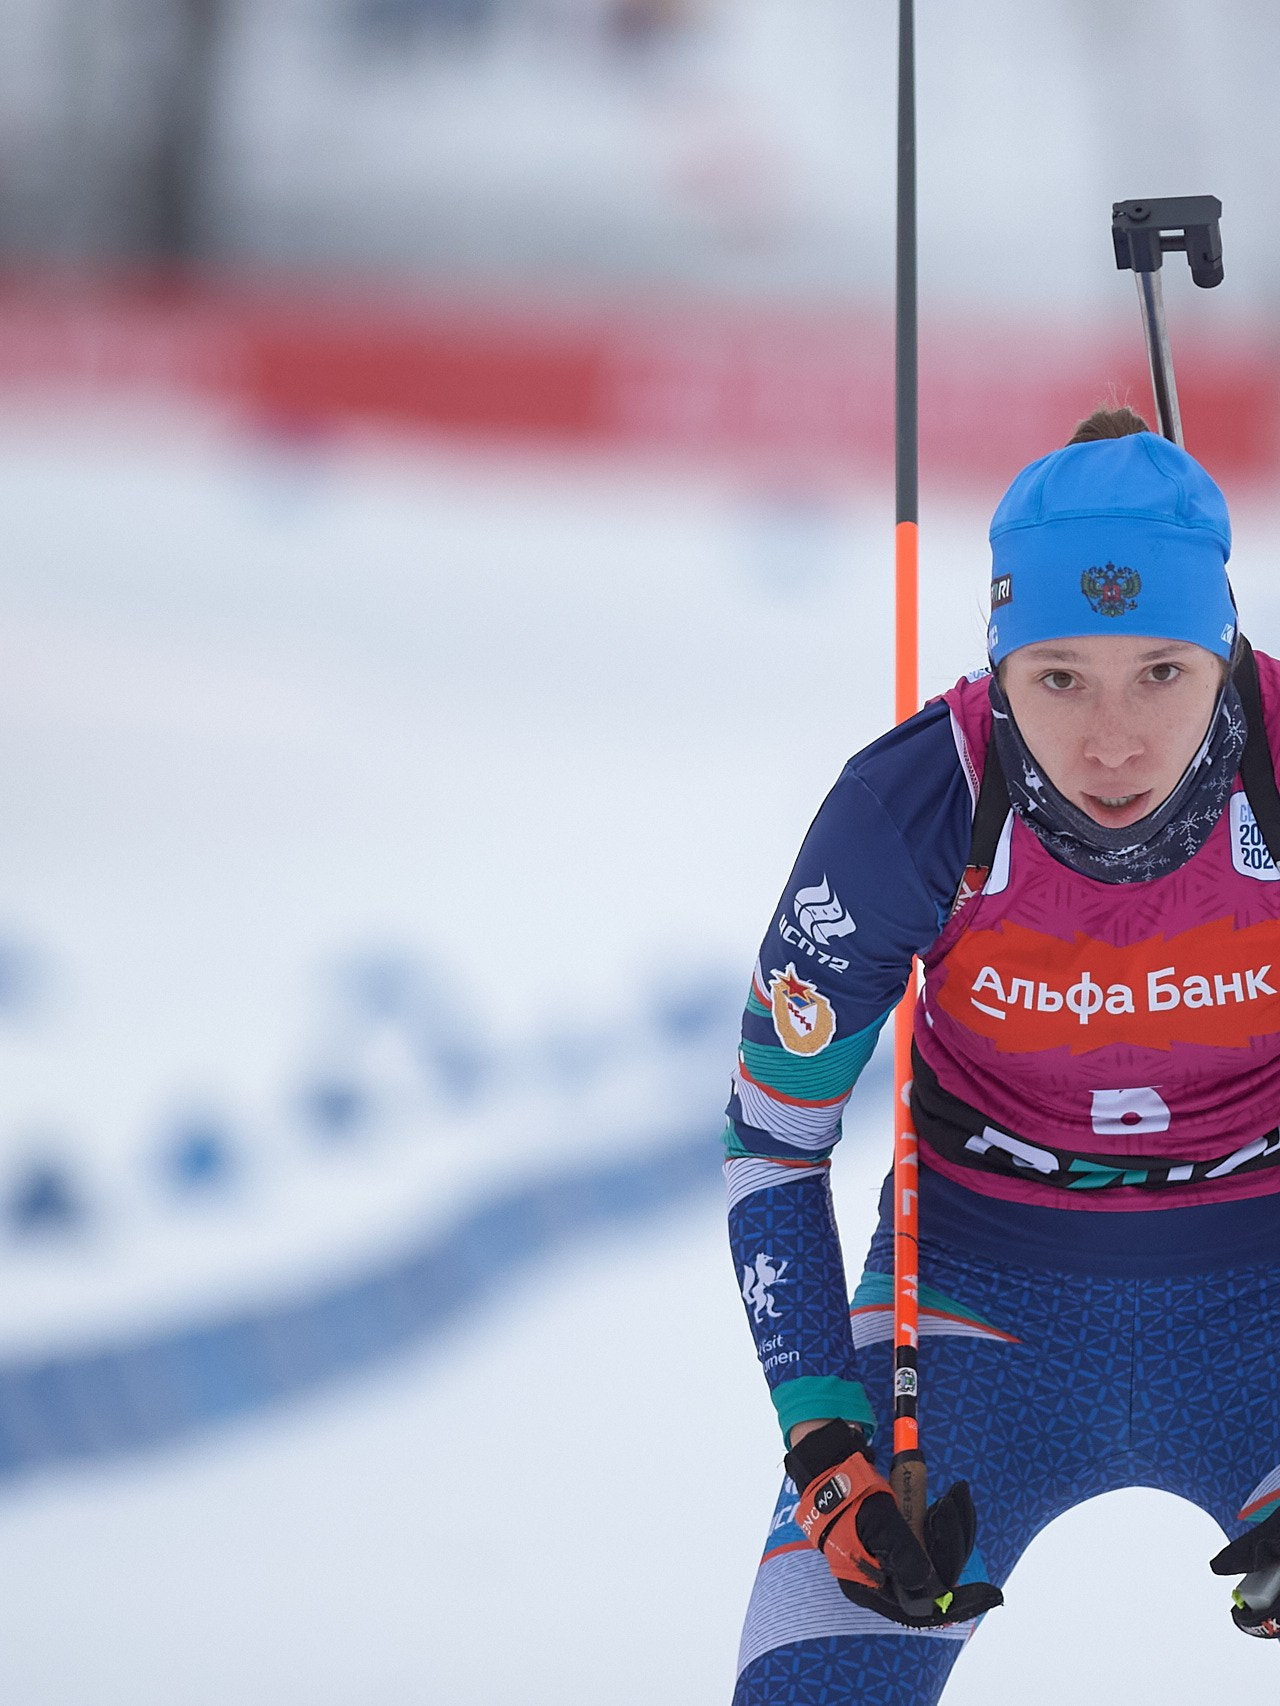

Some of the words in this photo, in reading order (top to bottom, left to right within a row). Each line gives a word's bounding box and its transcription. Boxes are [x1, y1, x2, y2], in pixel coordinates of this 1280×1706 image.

[1240, 823, 1263, 846] 20
[1241, 847, 1274, 870] 202
[970, 966, 1135, 1025] Альфа
[1147, 965, 1278, 1012] Банк
